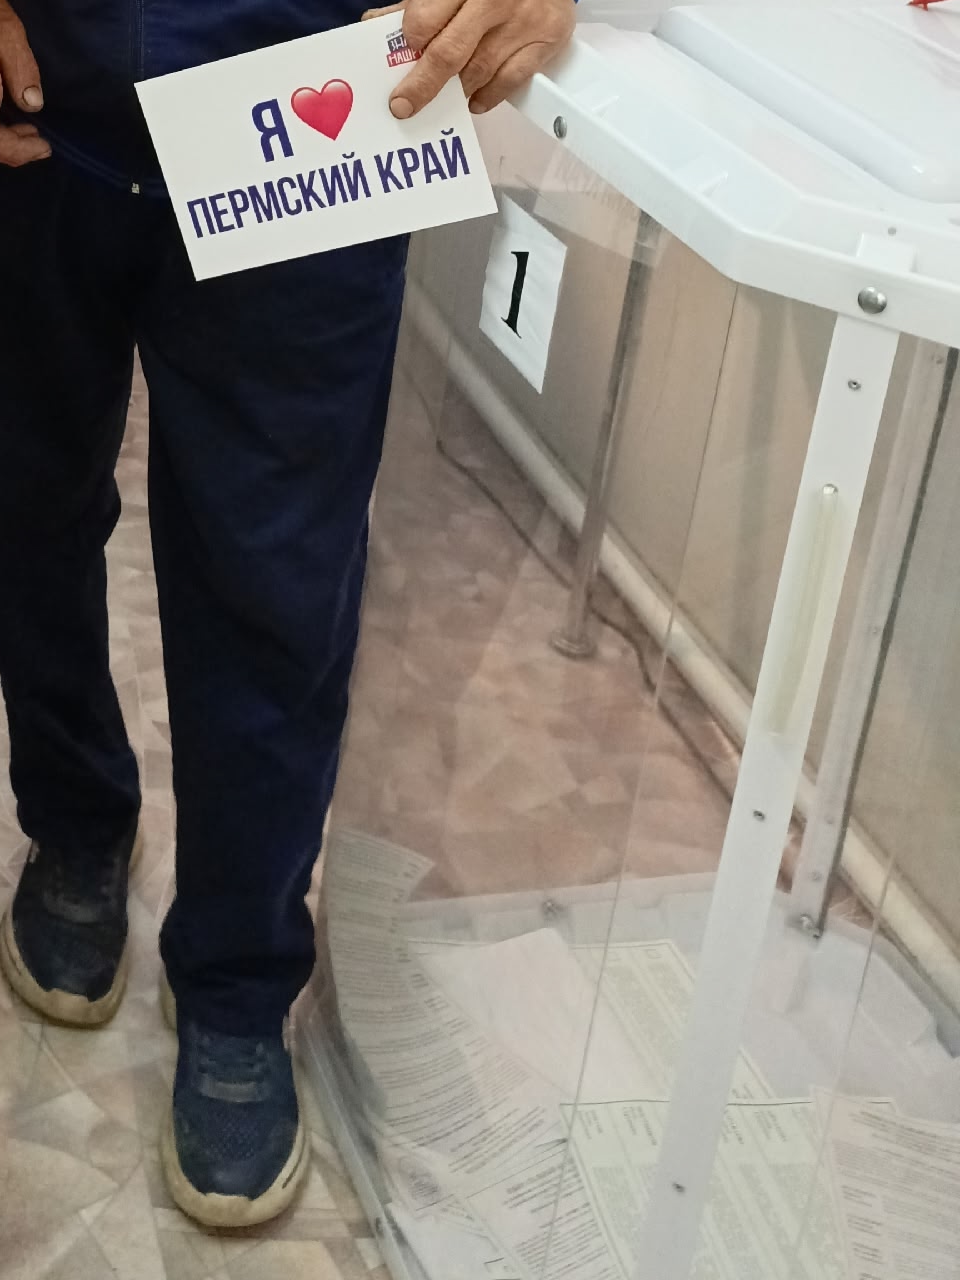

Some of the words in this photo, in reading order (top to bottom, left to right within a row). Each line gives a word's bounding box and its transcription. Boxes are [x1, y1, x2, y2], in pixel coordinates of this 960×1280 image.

[251, 98, 294, 163] Я
[187, 151, 371, 239] ПЕРМСКИЙ
[373, 127, 470, 194] КРАЙ
[501, 251, 530, 339] 1
